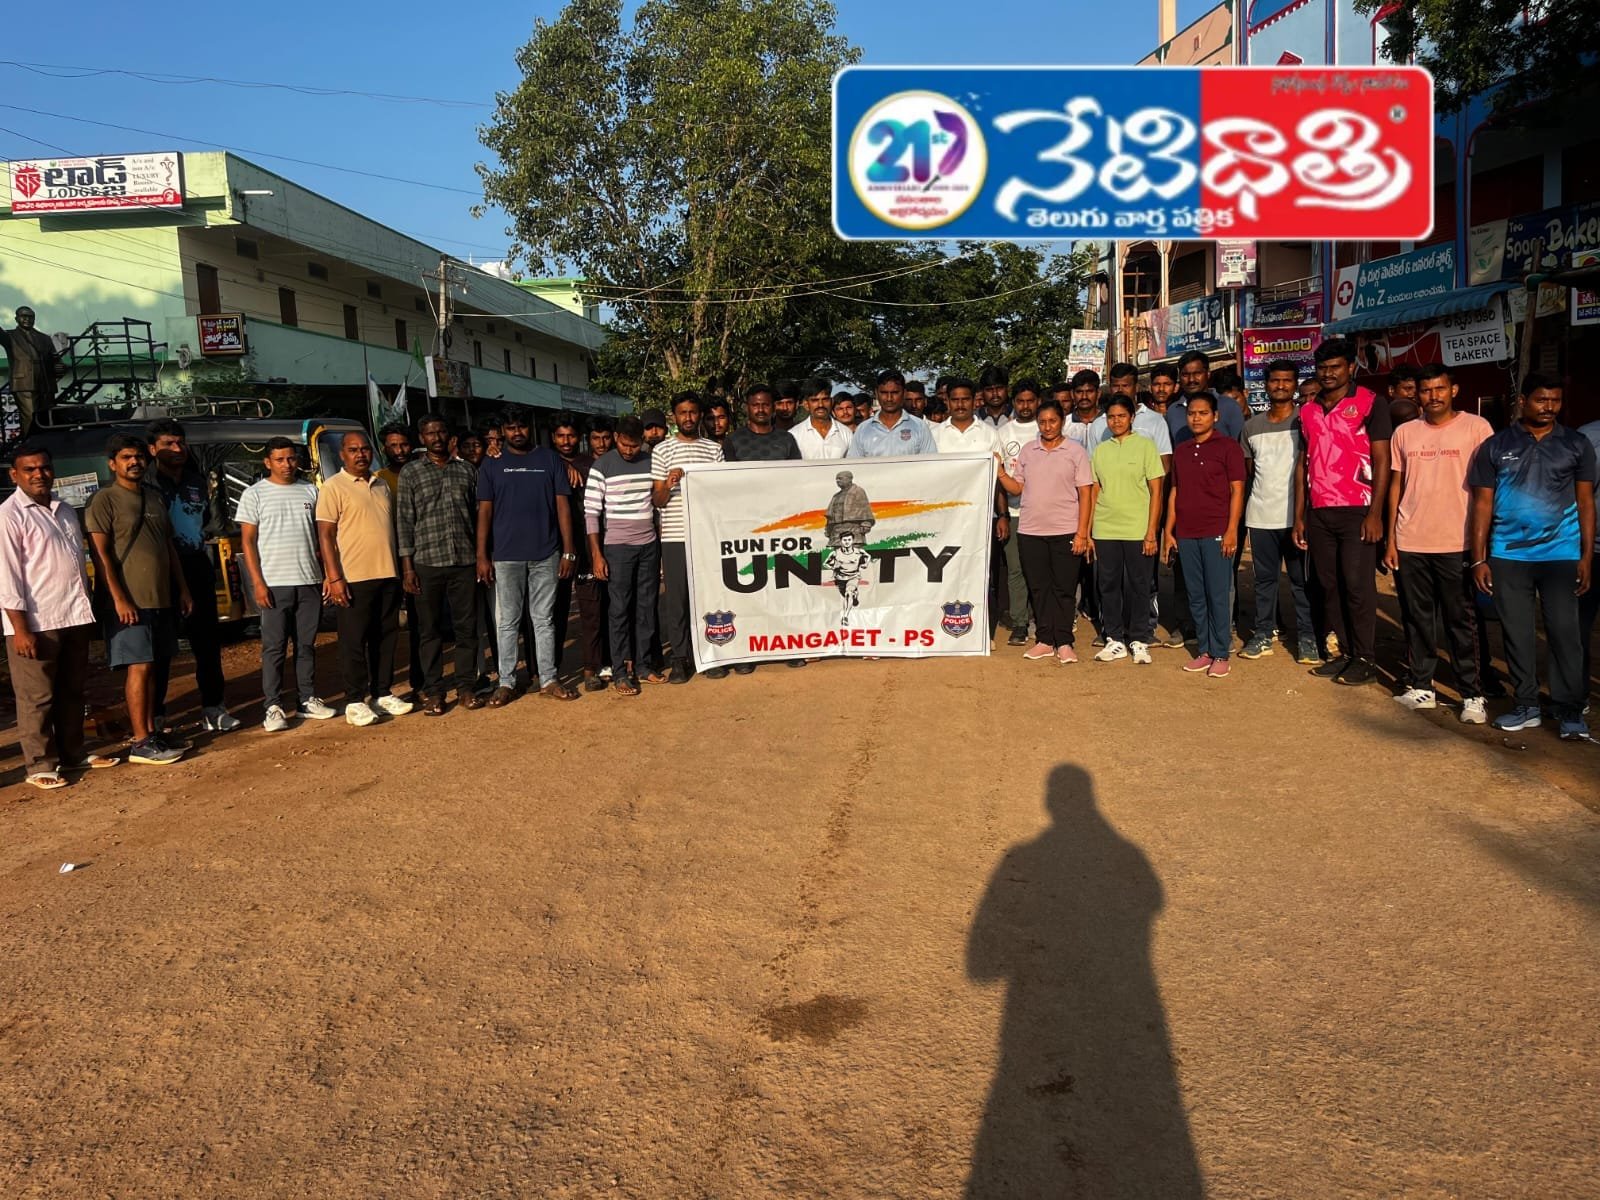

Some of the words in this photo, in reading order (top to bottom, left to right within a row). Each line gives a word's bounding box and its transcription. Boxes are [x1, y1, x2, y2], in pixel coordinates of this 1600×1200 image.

[48, 187, 99, 198] LODGE
[1356, 293, 1365, 309] A
[1366, 296, 1375, 308] to
[1377, 289, 1386, 306] Z
[1253, 337, 1312, 354] మయూరి
[1446, 338, 1465, 350] TEA
[1467, 333, 1501, 347] SPACE
[1454, 348, 1495, 361] BAKERY
[720, 540, 764, 556] RUN
[770, 536, 812, 552] FOR
[721, 545, 962, 594] UNTY
[944, 617, 971, 625] POLICE
[707, 626, 734, 634] POLICE
[749, 629, 882, 652] MANGAPET
[904, 629, 935, 647] PS
